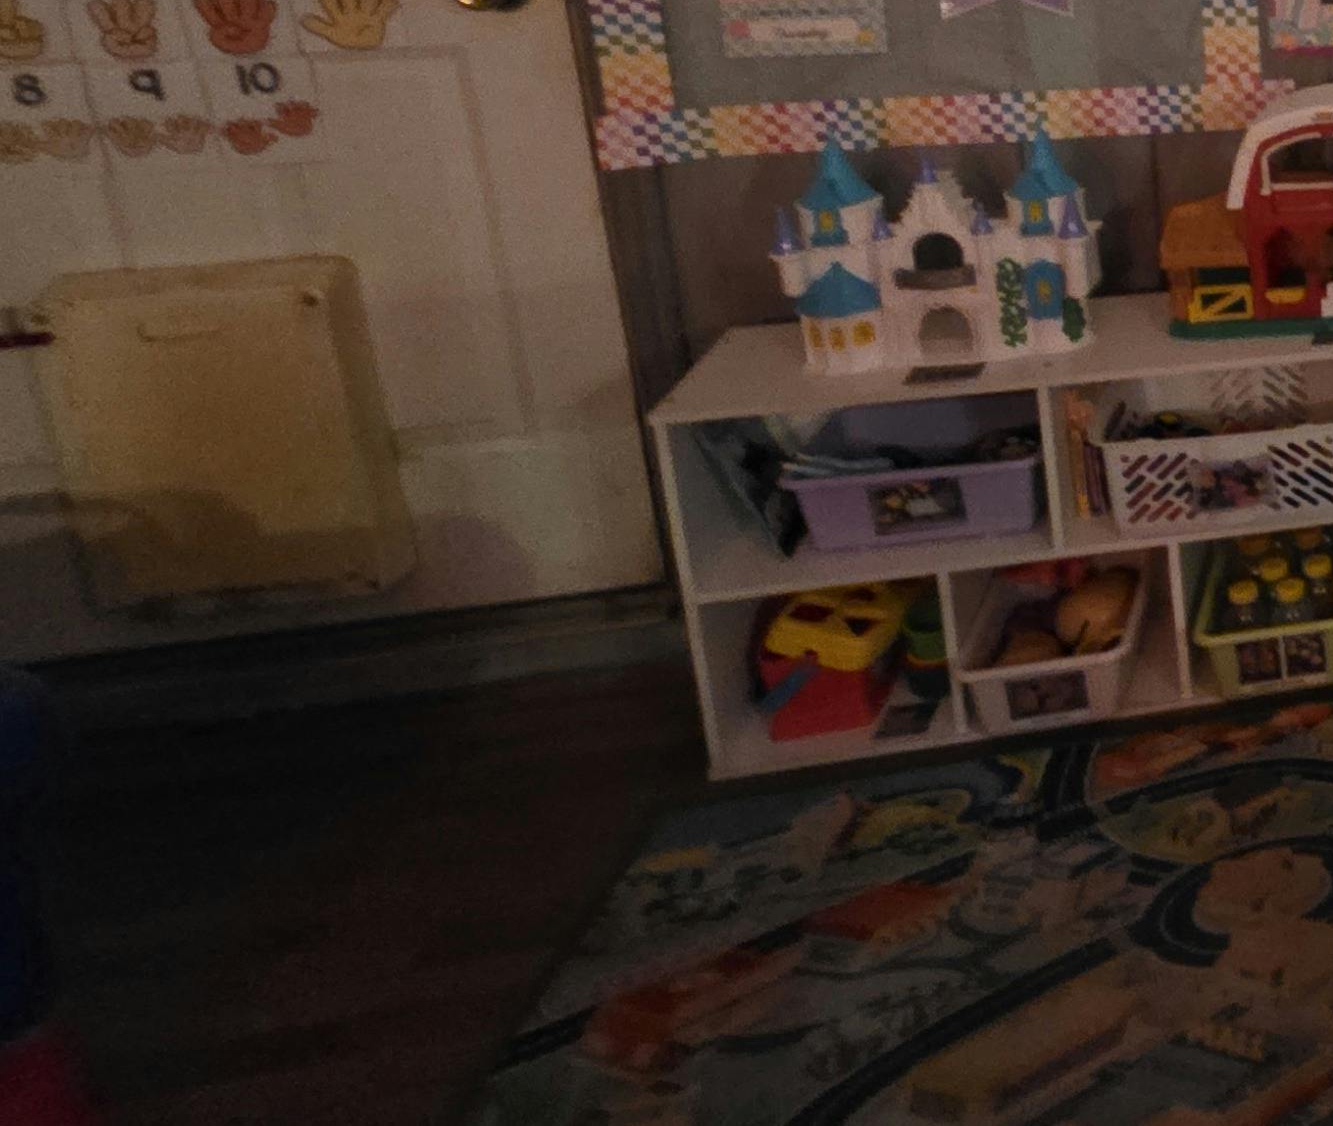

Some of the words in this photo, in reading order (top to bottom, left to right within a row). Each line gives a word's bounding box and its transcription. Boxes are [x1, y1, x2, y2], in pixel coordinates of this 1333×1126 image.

[13, 73, 48, 106] 8
[128, 68, 167, 101] 9
[235, 61, 282, 96] 10
